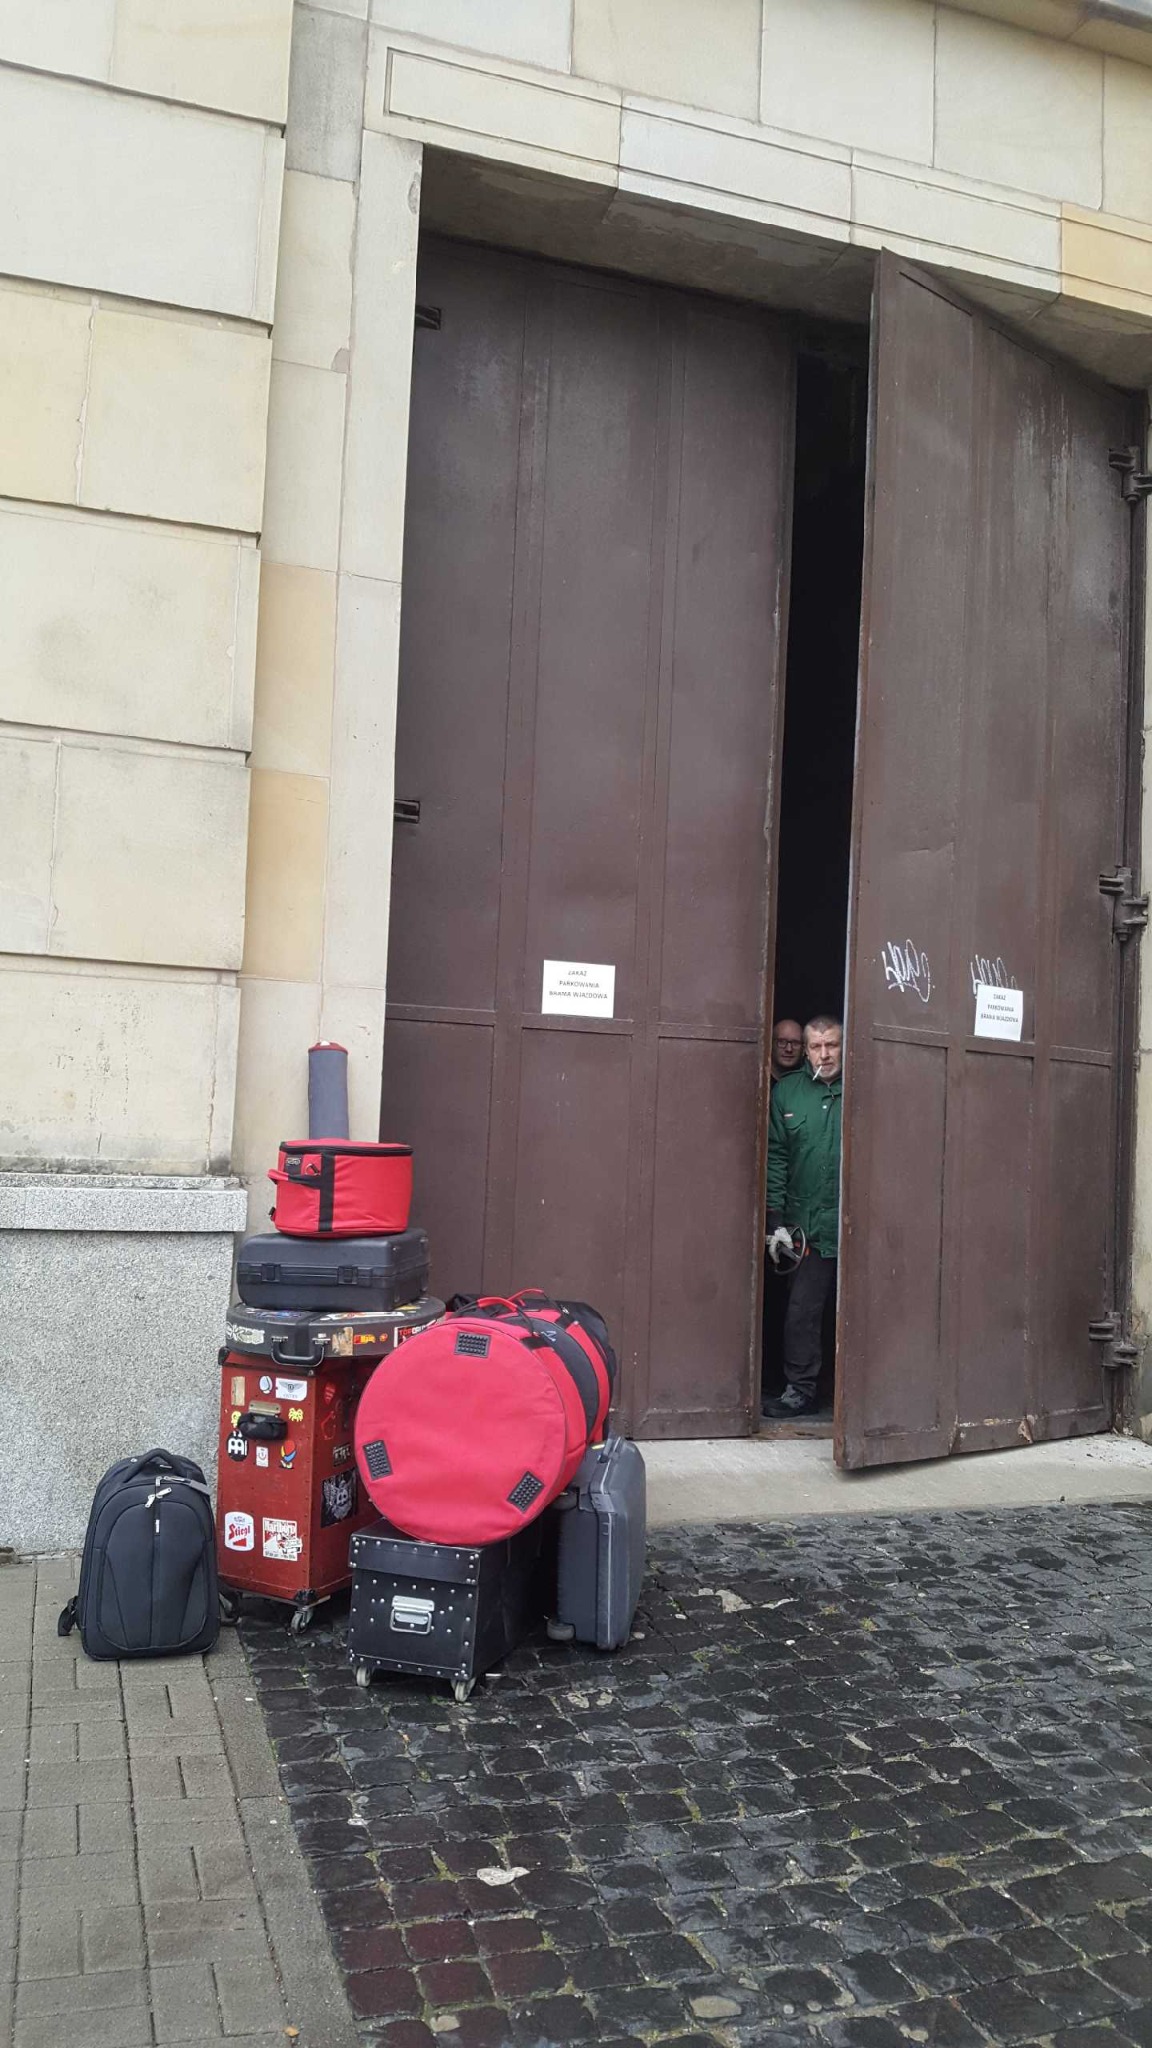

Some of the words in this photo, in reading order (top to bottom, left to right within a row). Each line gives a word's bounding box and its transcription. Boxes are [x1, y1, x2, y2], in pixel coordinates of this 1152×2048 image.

[559, 980, 600, 989] PARKOWANIA
[549, 990, 571, 998] BRAMA
[573, 992, 608, 1000] WJAZDOWA
[229, 1523, 251, 1540] Stiegl
